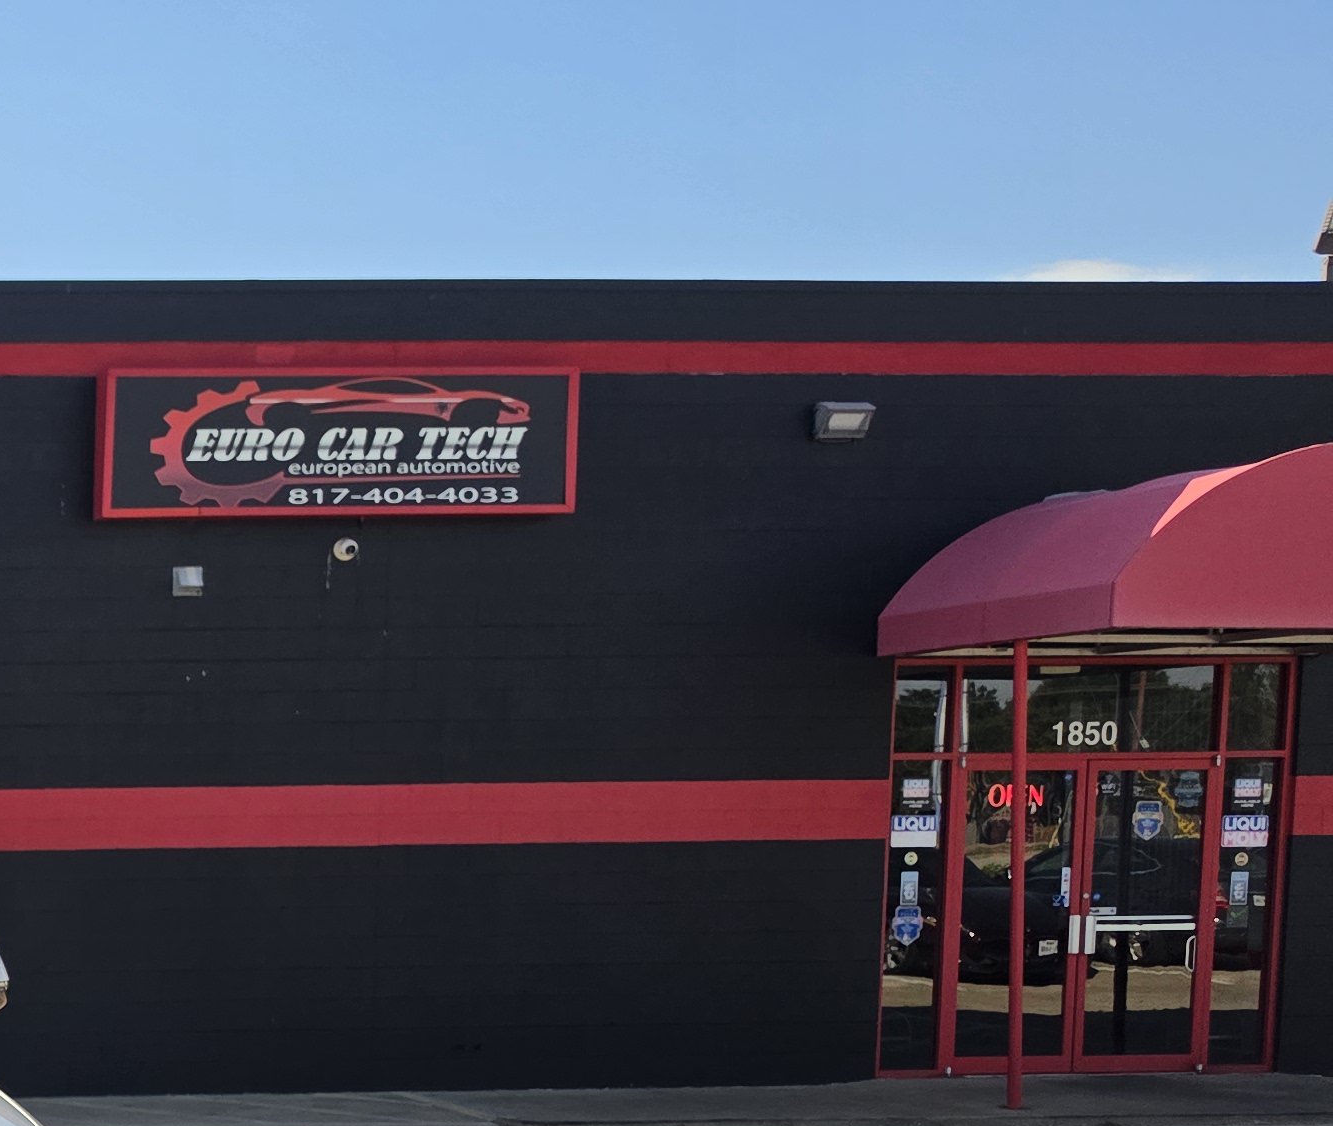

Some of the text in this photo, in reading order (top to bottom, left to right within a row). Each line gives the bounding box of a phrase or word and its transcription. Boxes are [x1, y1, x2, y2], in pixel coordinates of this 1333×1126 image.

[185, 426, 528, 462] EURO CAR TECH
[288, 459, 521, 478] european automotive
[288, 486, 519, 505] 817-404-4033
[1052, 720, 1118, 746] 1850
[988, 783, 1044, 807] ON
[893, 816, 935, 831] LIQUI
[1224, 816, 1266, 831] LIQUI
